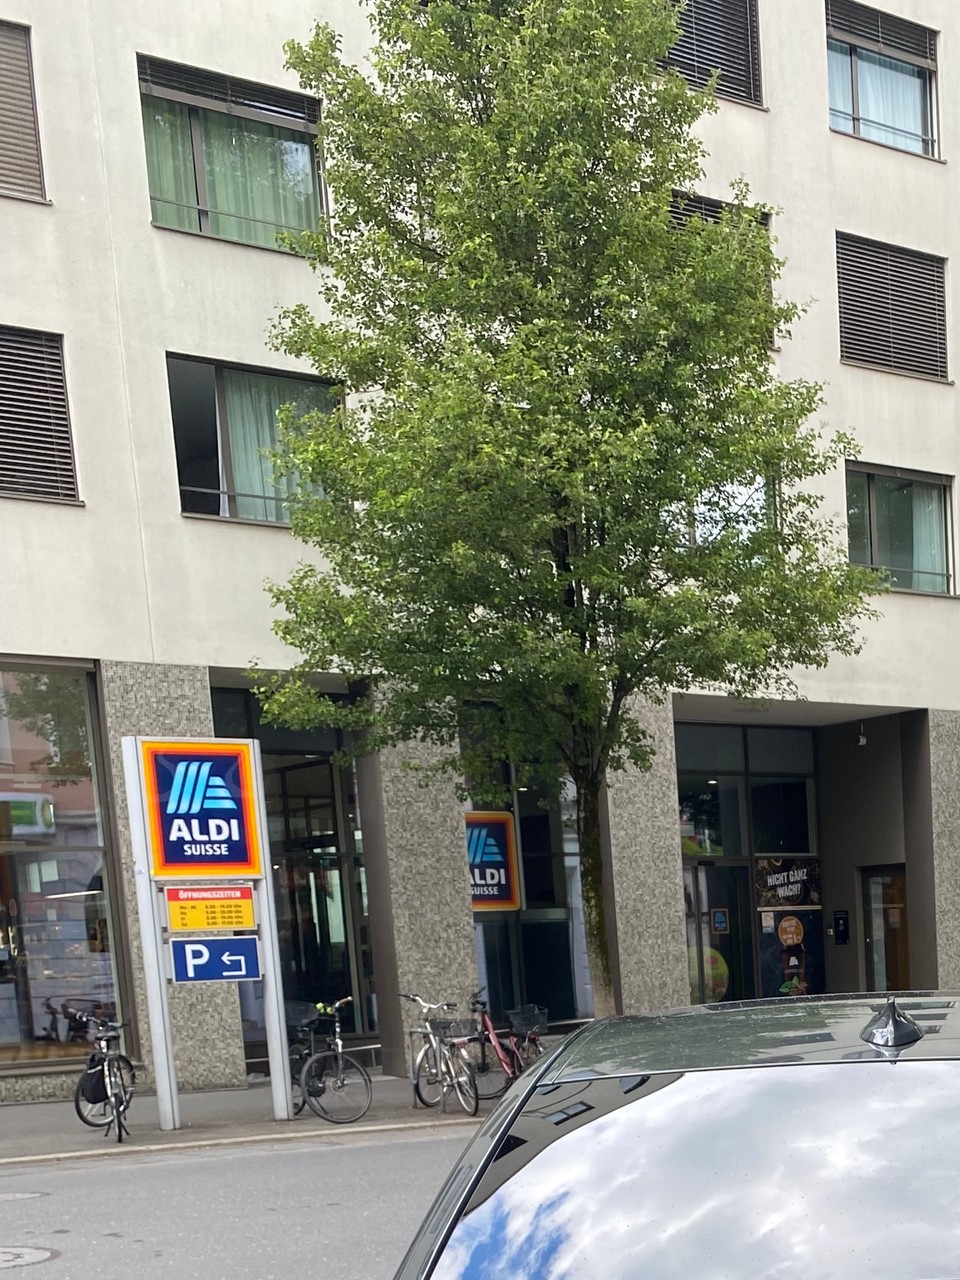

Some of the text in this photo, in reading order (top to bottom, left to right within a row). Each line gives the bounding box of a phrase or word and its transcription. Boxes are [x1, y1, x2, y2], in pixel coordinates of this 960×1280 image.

[169, 818, 240, 842] ALDI
[184, 843, 229, 855] SUISSE
[767, 868, 808, 887] NICHT GANZ
[178, 889, 241, 899] ÖFFNUNGSZEITEN
[777, 883, 801, 898] WACH?
[184, 943, 210, 978] P
